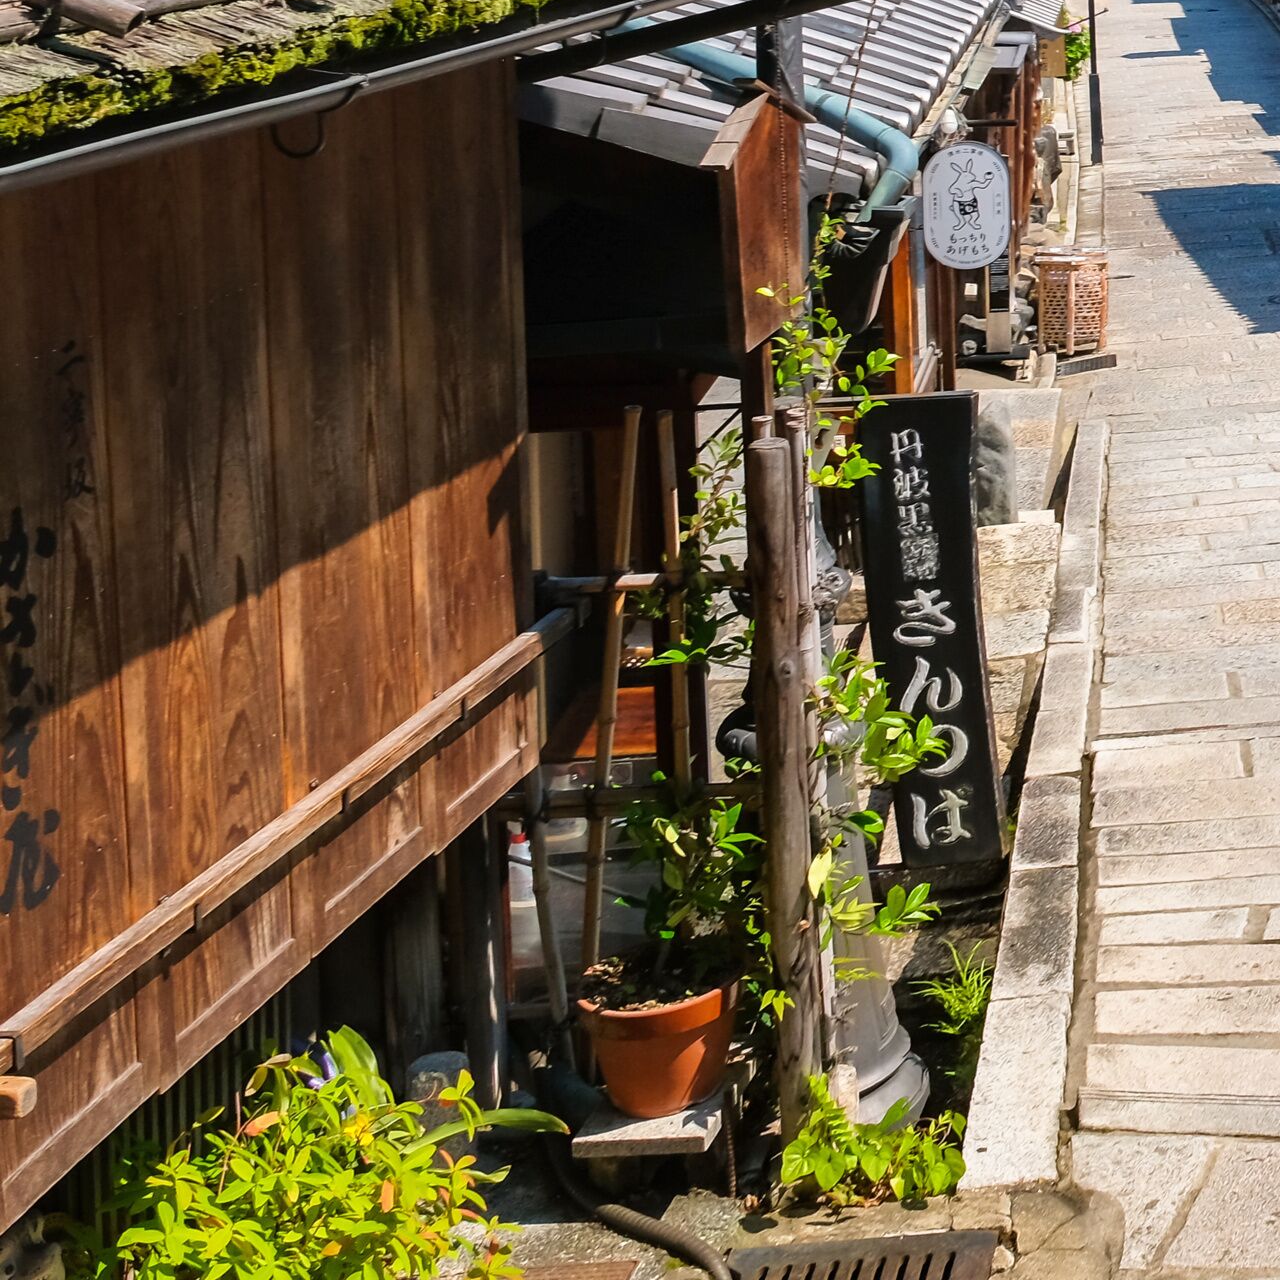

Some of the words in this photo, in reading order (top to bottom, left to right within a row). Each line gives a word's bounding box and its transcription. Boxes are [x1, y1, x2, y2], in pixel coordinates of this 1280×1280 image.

[950, 233, 986, 244] もっちり
[946, 244, 990, 256] あげもち
